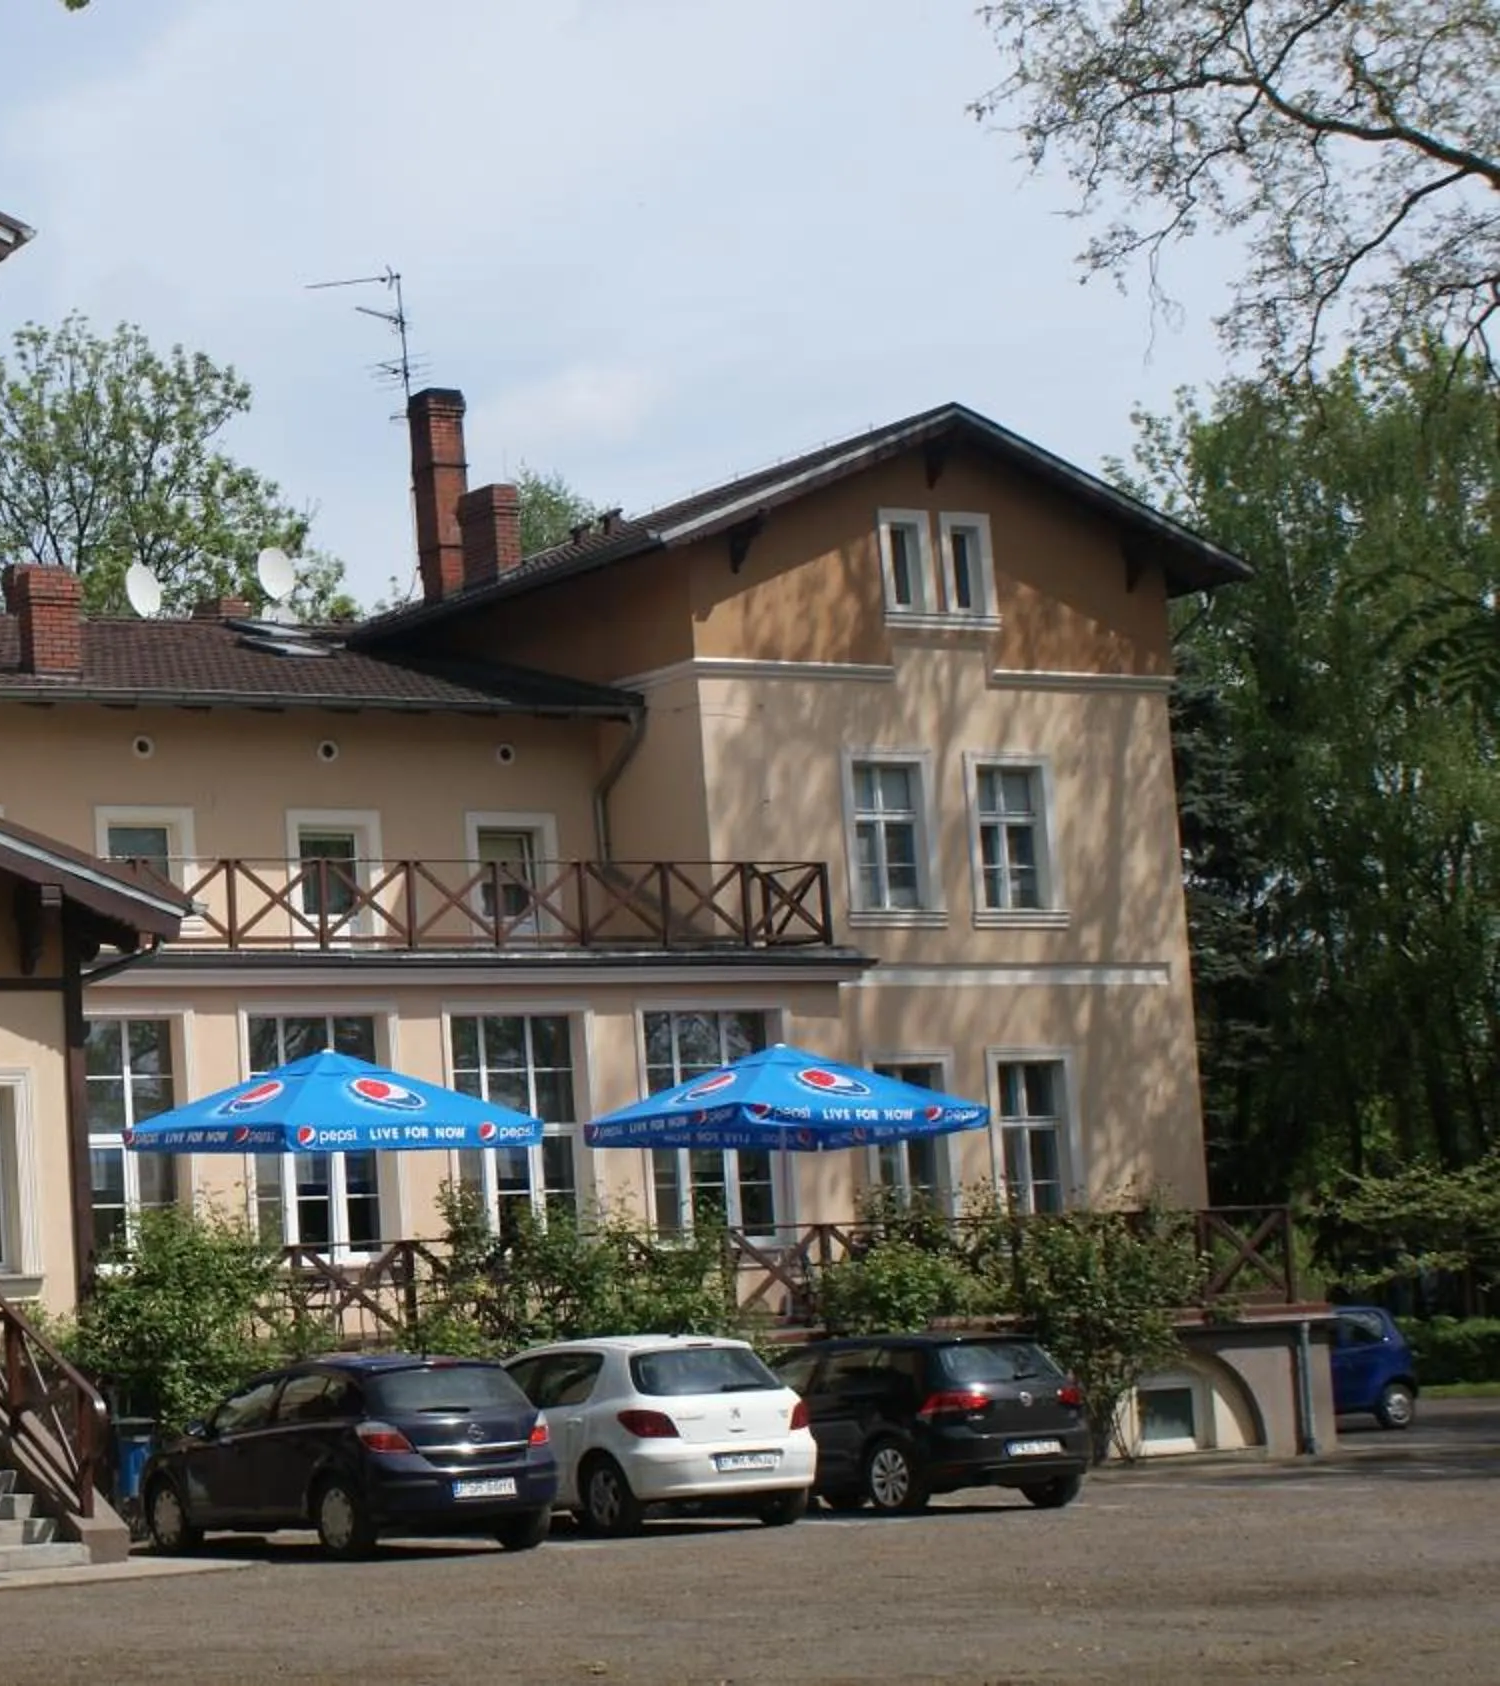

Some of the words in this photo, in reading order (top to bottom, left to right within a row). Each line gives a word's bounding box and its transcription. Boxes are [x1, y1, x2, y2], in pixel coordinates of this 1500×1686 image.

[822, 1108, 850, 1121] LIVE
[855, 1108, 879, 1121] FOR
[319, 1127, 358, 1144] pepsi
[369, 1126, 399, 1140] LIVE
[404, 1126, 429, 1139] FOR
[435, 1125, 466, 1139] NOW
[499, 1124, 535, 1140] pepsi
